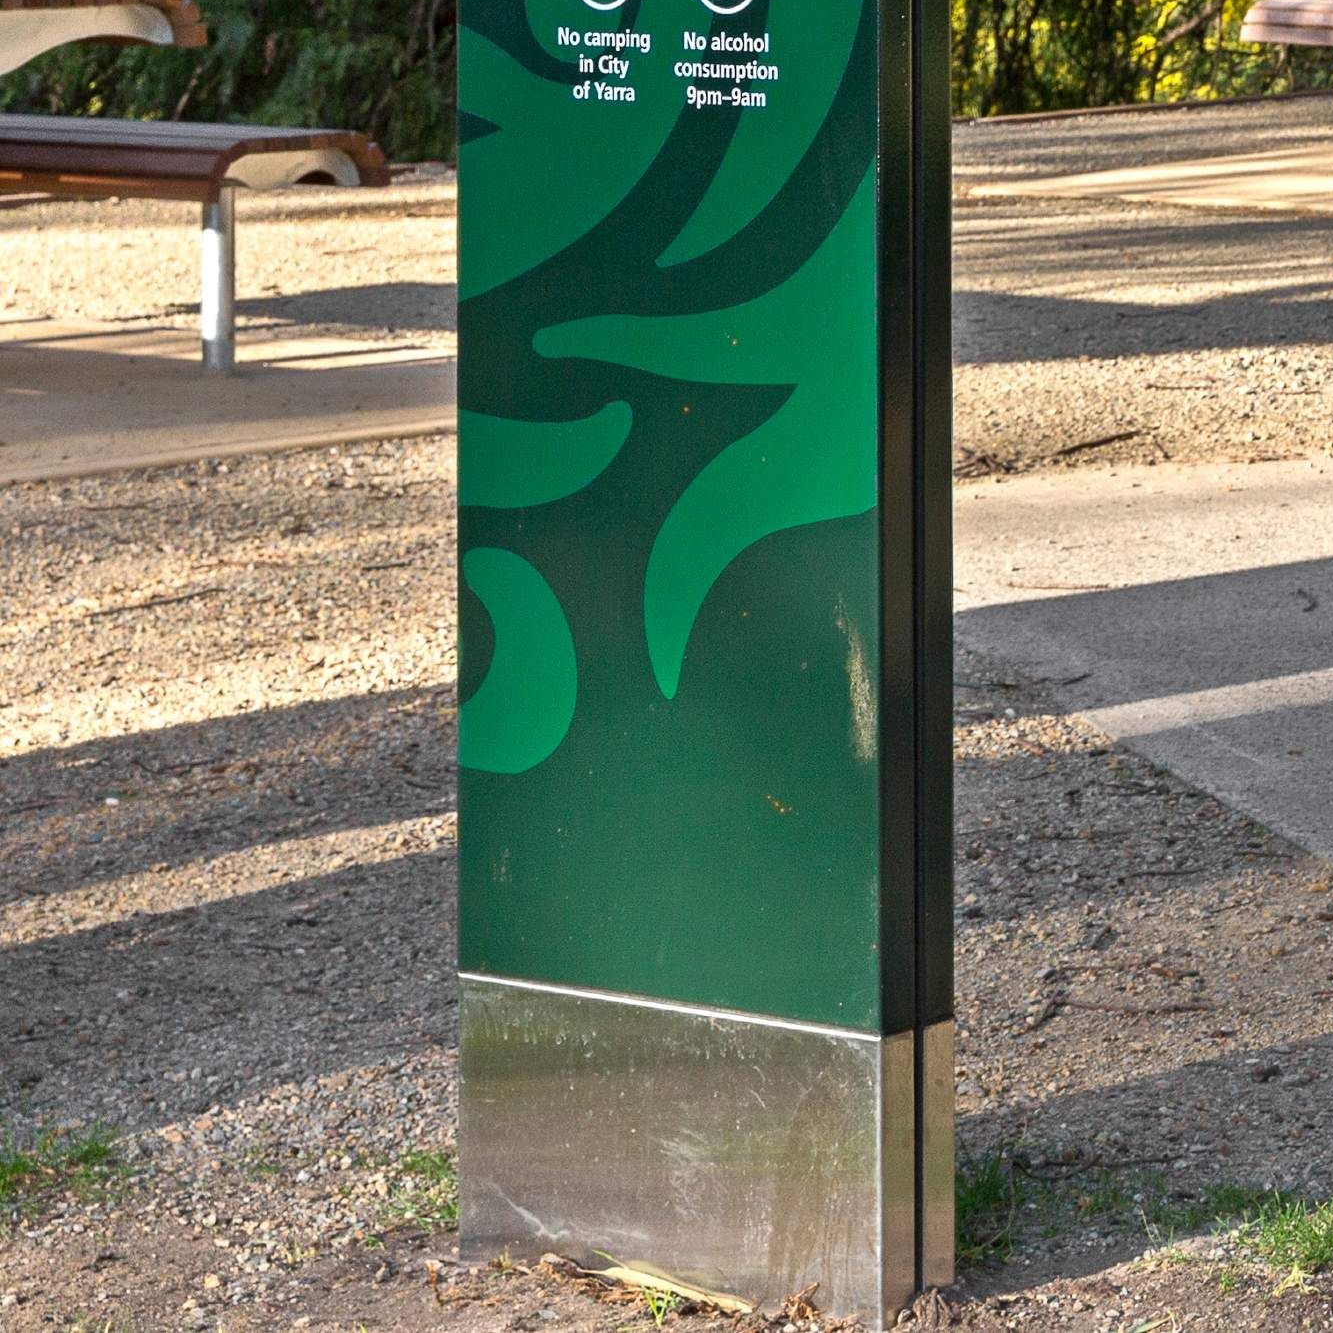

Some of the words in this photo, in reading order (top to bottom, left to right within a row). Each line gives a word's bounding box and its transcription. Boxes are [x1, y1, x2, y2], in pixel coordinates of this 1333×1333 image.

[558, 27, 580, 45] No
[584, 29, 650, 52] camping
[684, 32, 706, 50] No
[711, 32, 768, 52] alcohol
[580, 55, 593, 72] in
[599, 55, 629, 78] City
[674, 61, 778, 83] consumption
[573, 81, 590, 99] of
[594, 82, 635, 101] Yarra
